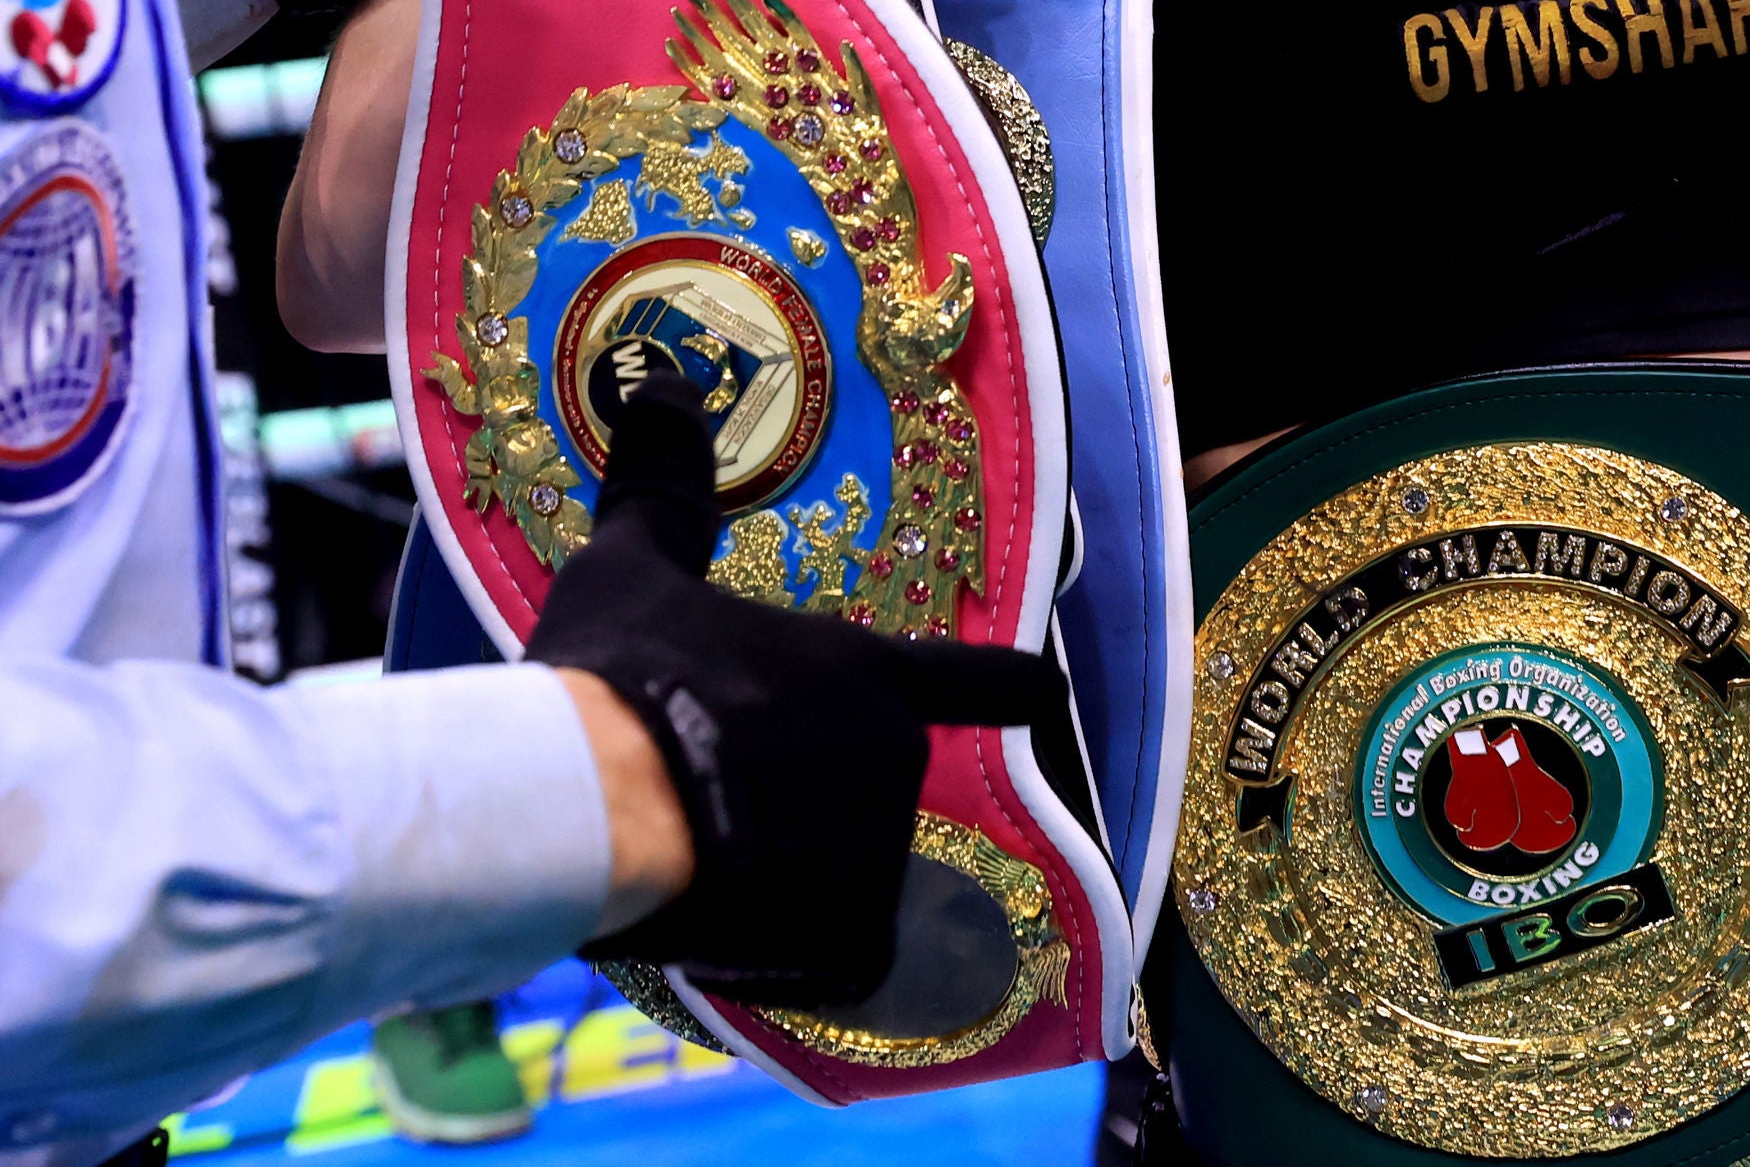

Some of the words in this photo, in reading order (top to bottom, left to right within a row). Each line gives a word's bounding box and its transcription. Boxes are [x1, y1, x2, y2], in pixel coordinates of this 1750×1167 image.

[721, 245, 783, 295] WORLD
[781, 294, 822, 373] FEMALE
[1229, 586, 1370, 775] WORLD
[1399, 530, 1733, 647] CHAMPION
[1371, 683, 1430, 819] International
[1429, 658, 1502, 696] Boxing
[1508, 655, 1628, 743] Organization
[1395, 685, 1607, 818] CHAMPIONSHIP
[1466, 884, 1646, 973] IBO
[1467, 840, 1600, 905] BOXING
